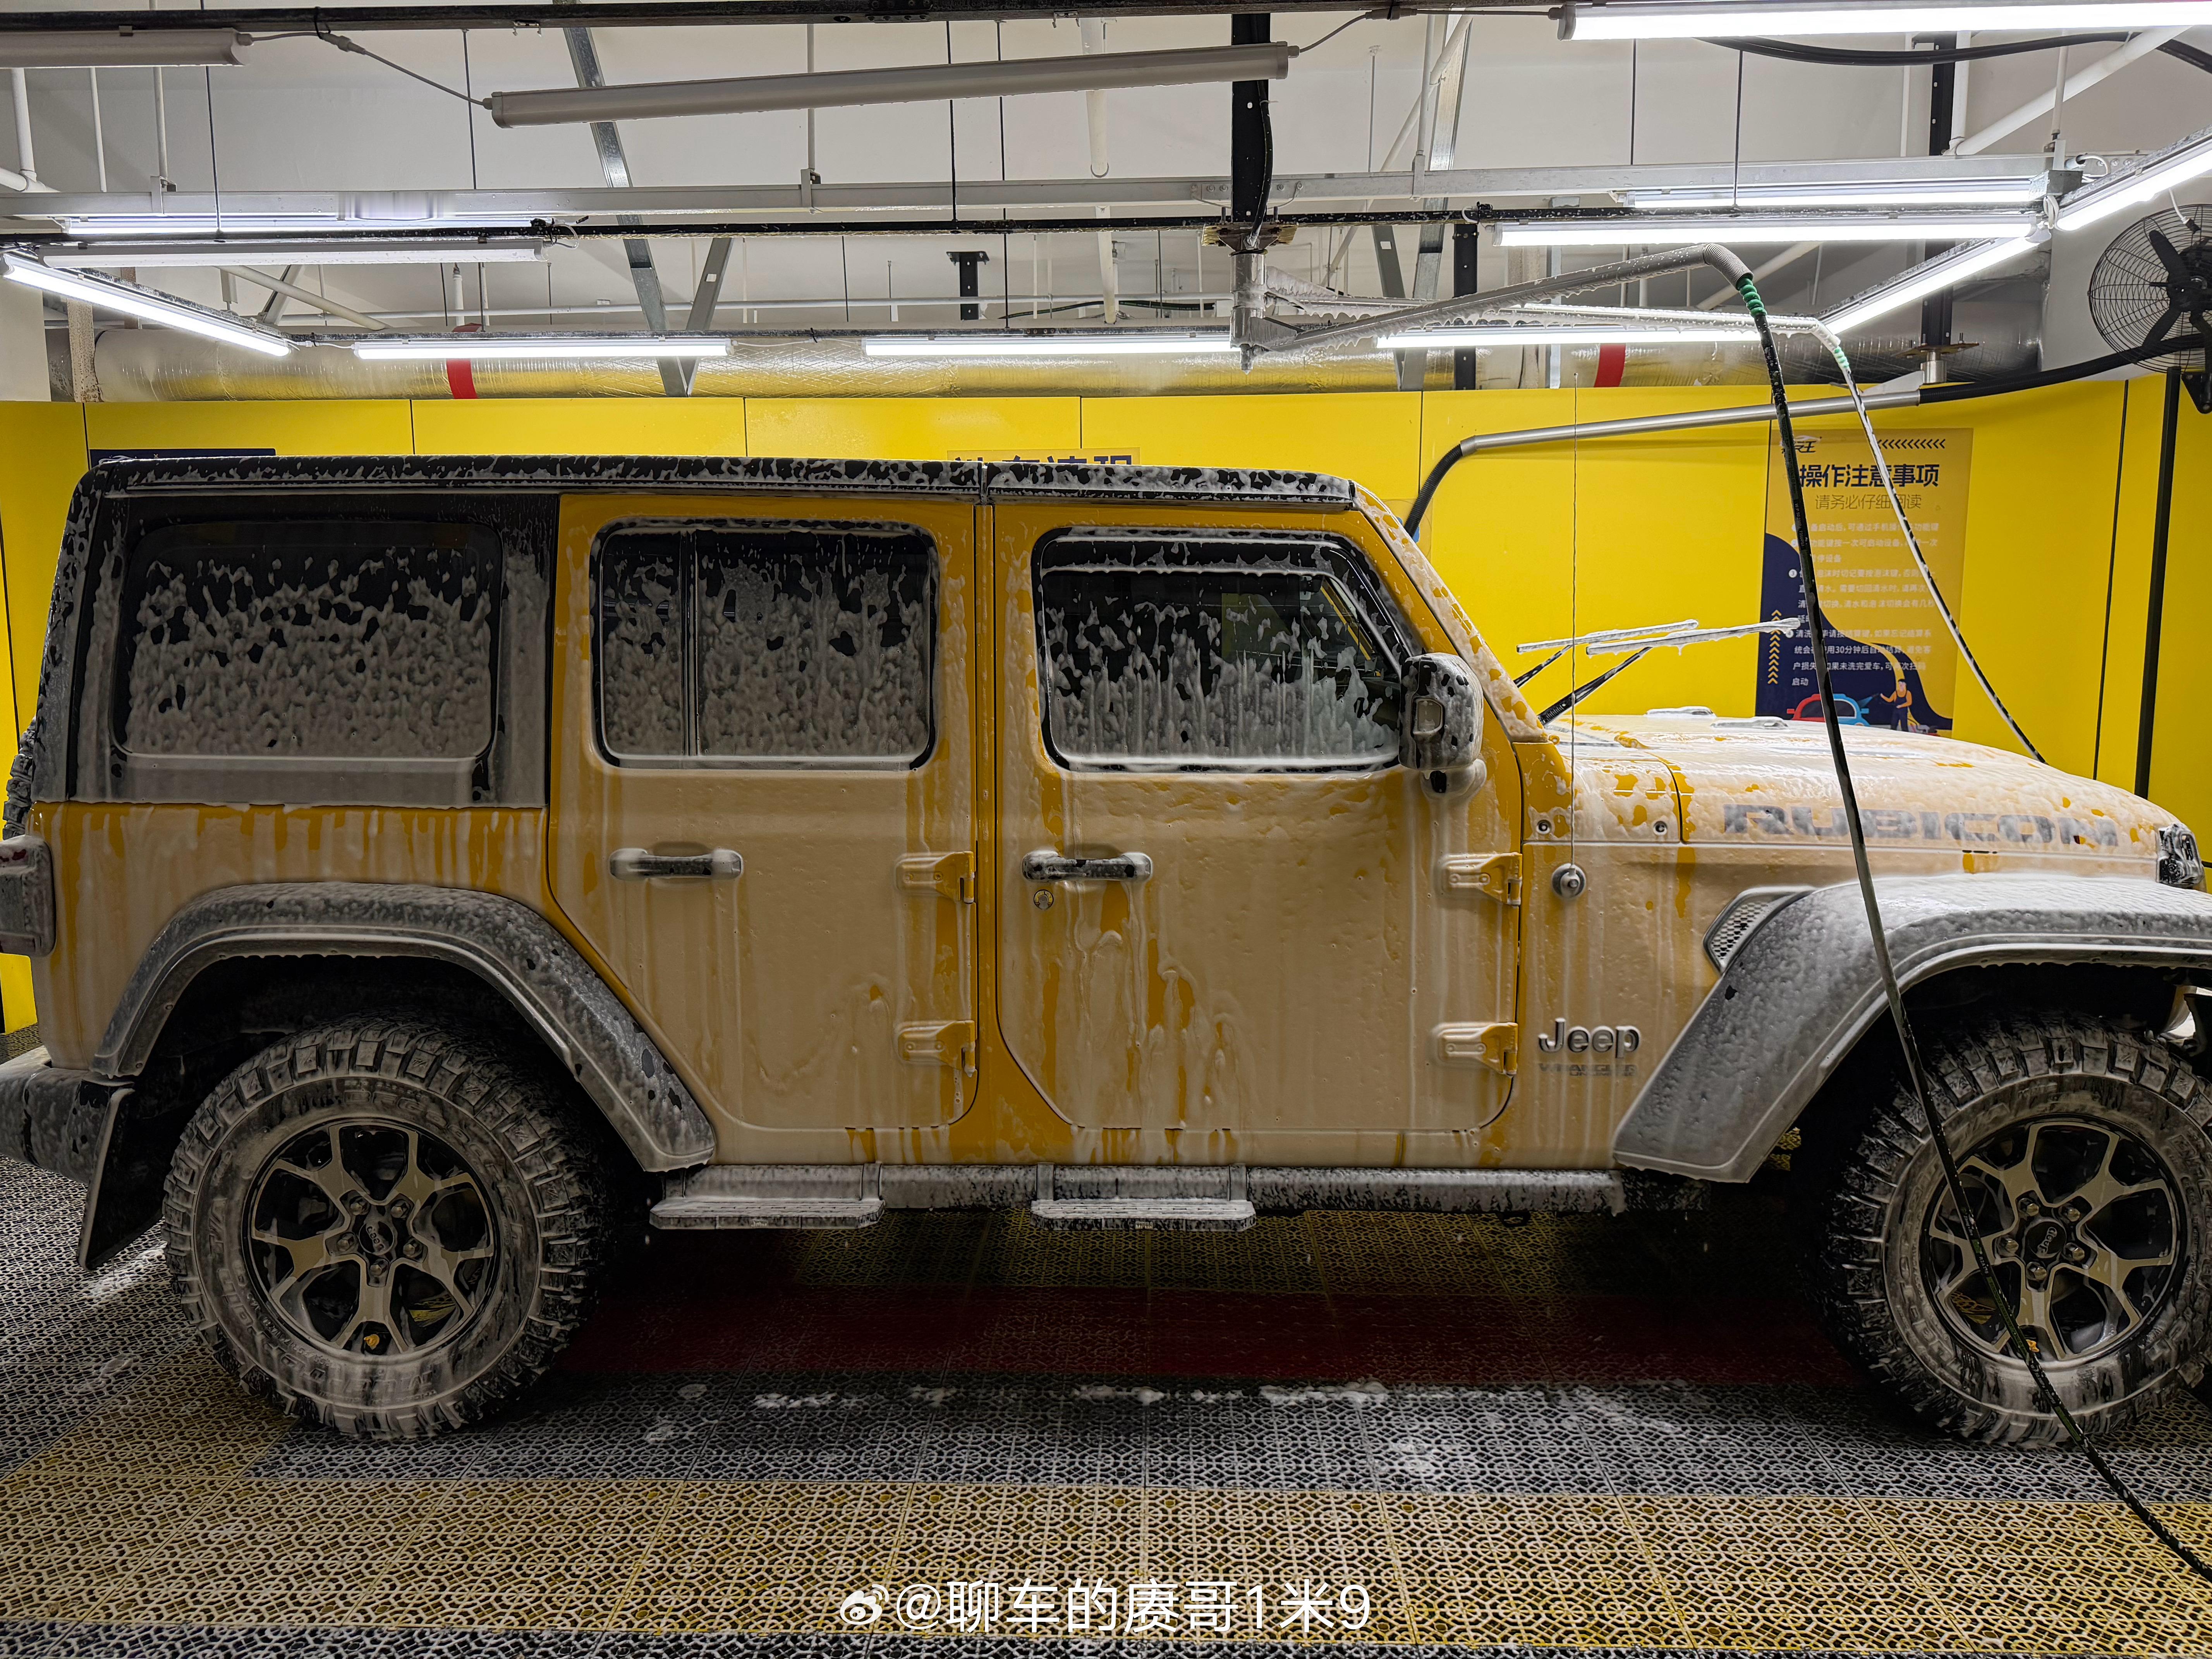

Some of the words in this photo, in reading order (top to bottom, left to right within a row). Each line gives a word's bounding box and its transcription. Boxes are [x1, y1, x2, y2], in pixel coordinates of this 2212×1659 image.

[1798, 464, 1939, 487] 操作注意事项
[1815, 494, 1922, 510] 请务必仔细阅读
[1791, 677, 1809, 686] 启动
[1723, 803, 2119, 847] RUBICON
[1538, 1017, 1641, 1058] Jeep
